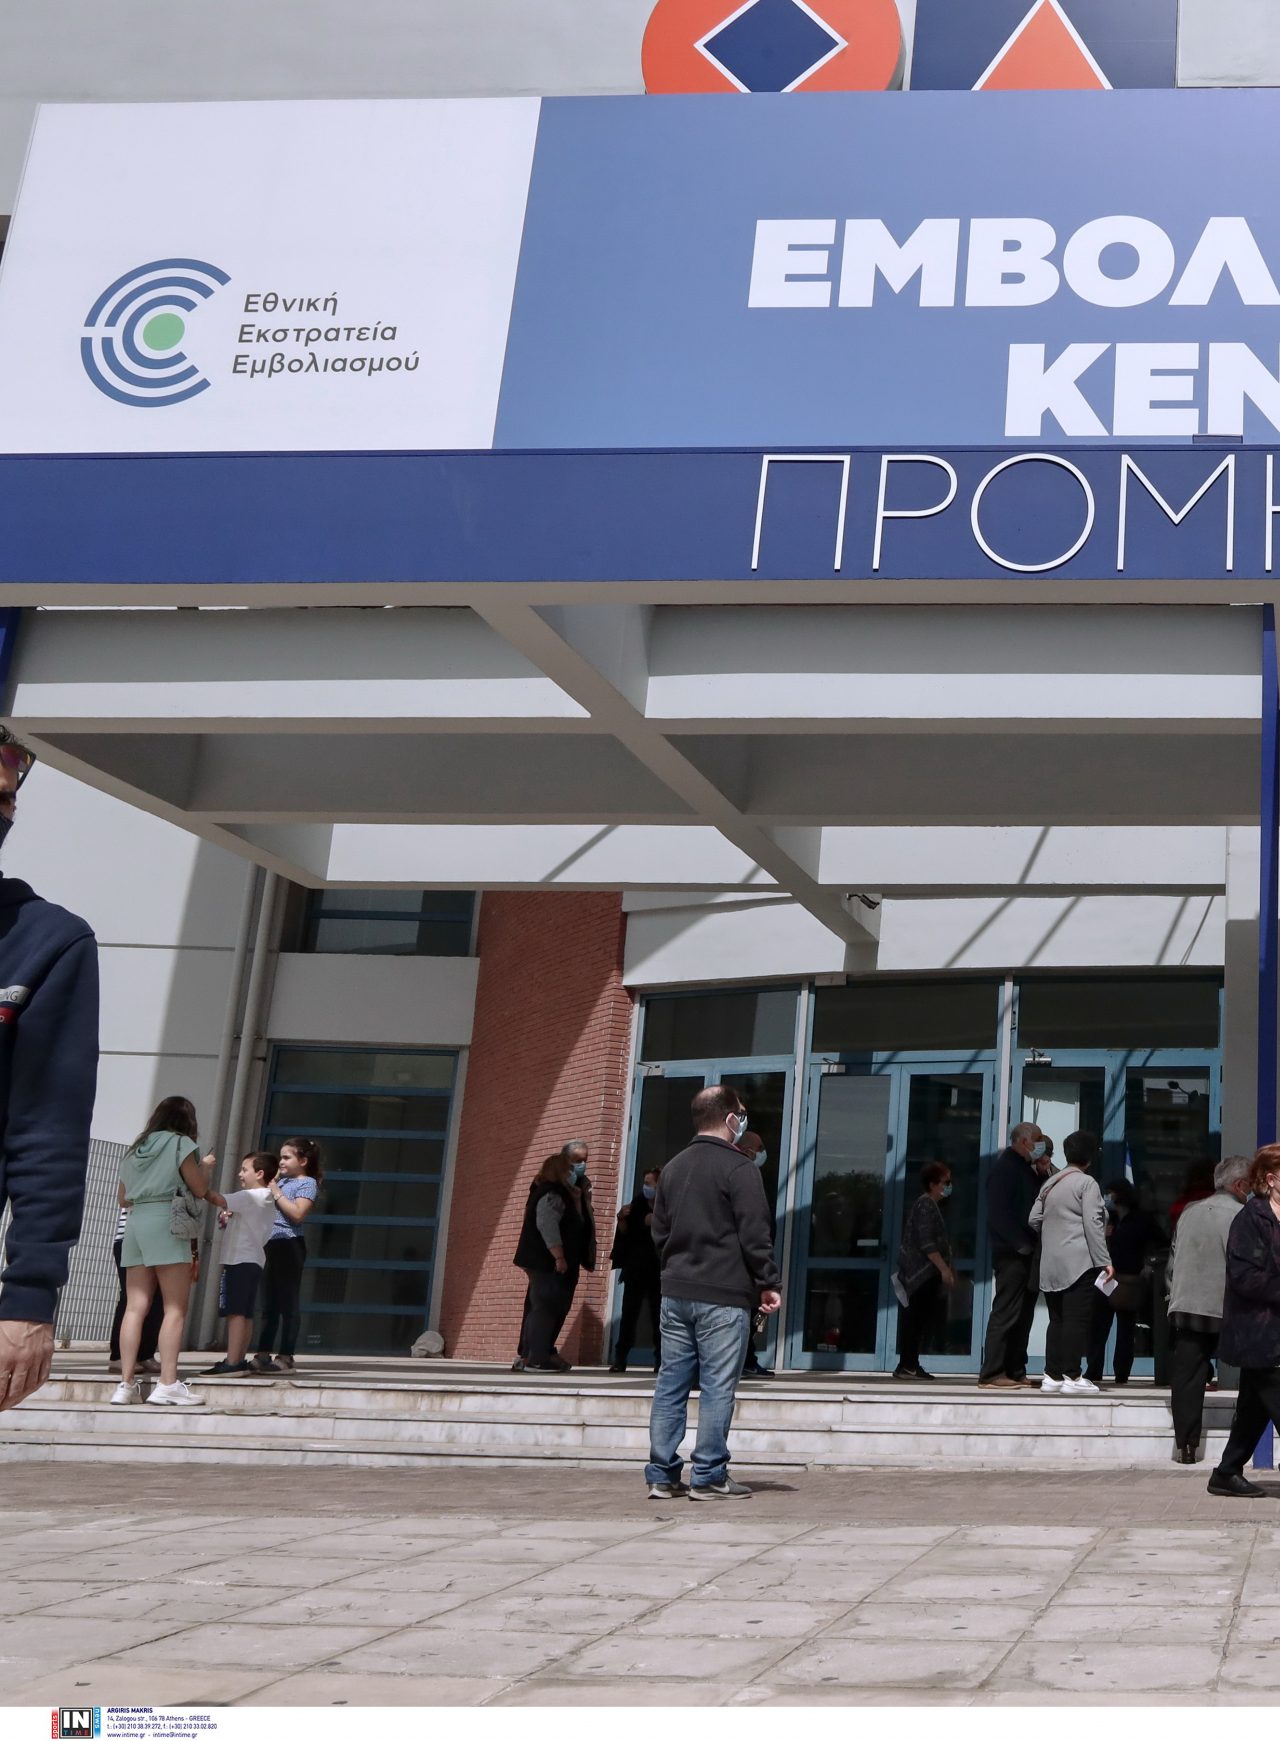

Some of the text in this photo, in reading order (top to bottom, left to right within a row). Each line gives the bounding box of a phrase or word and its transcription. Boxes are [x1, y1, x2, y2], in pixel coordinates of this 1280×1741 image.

[243, 292, 338, 315] Εθνική
[238, 321, 398, 347] Εκστρατεία
[232, 350, 420, 379] Εμβολιασμού
